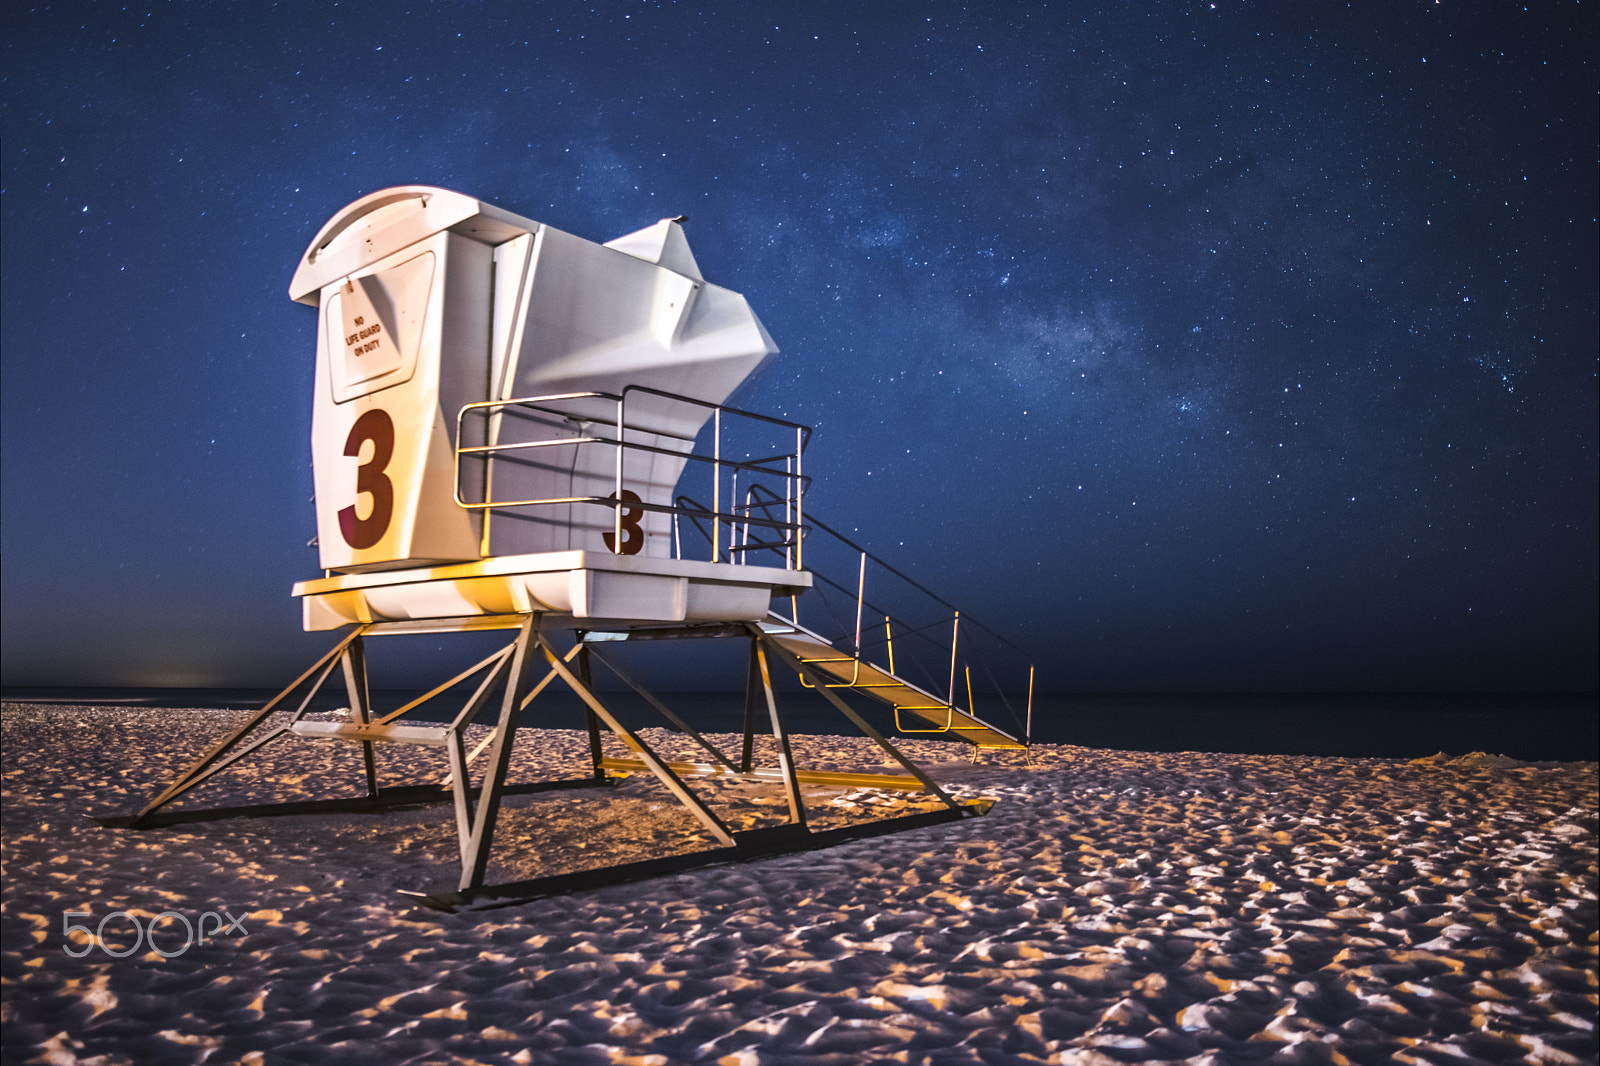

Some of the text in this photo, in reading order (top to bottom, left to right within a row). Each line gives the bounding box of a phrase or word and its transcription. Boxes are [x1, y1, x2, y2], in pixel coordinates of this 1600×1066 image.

[354, 316, 364, 327] NO
[345, 323, 381, 346] LIFE GUARD
[354, 338, 380, 357] ON DUTY
[337, 408, 395, 550] 3
[602, 489, 644, 556] 3
